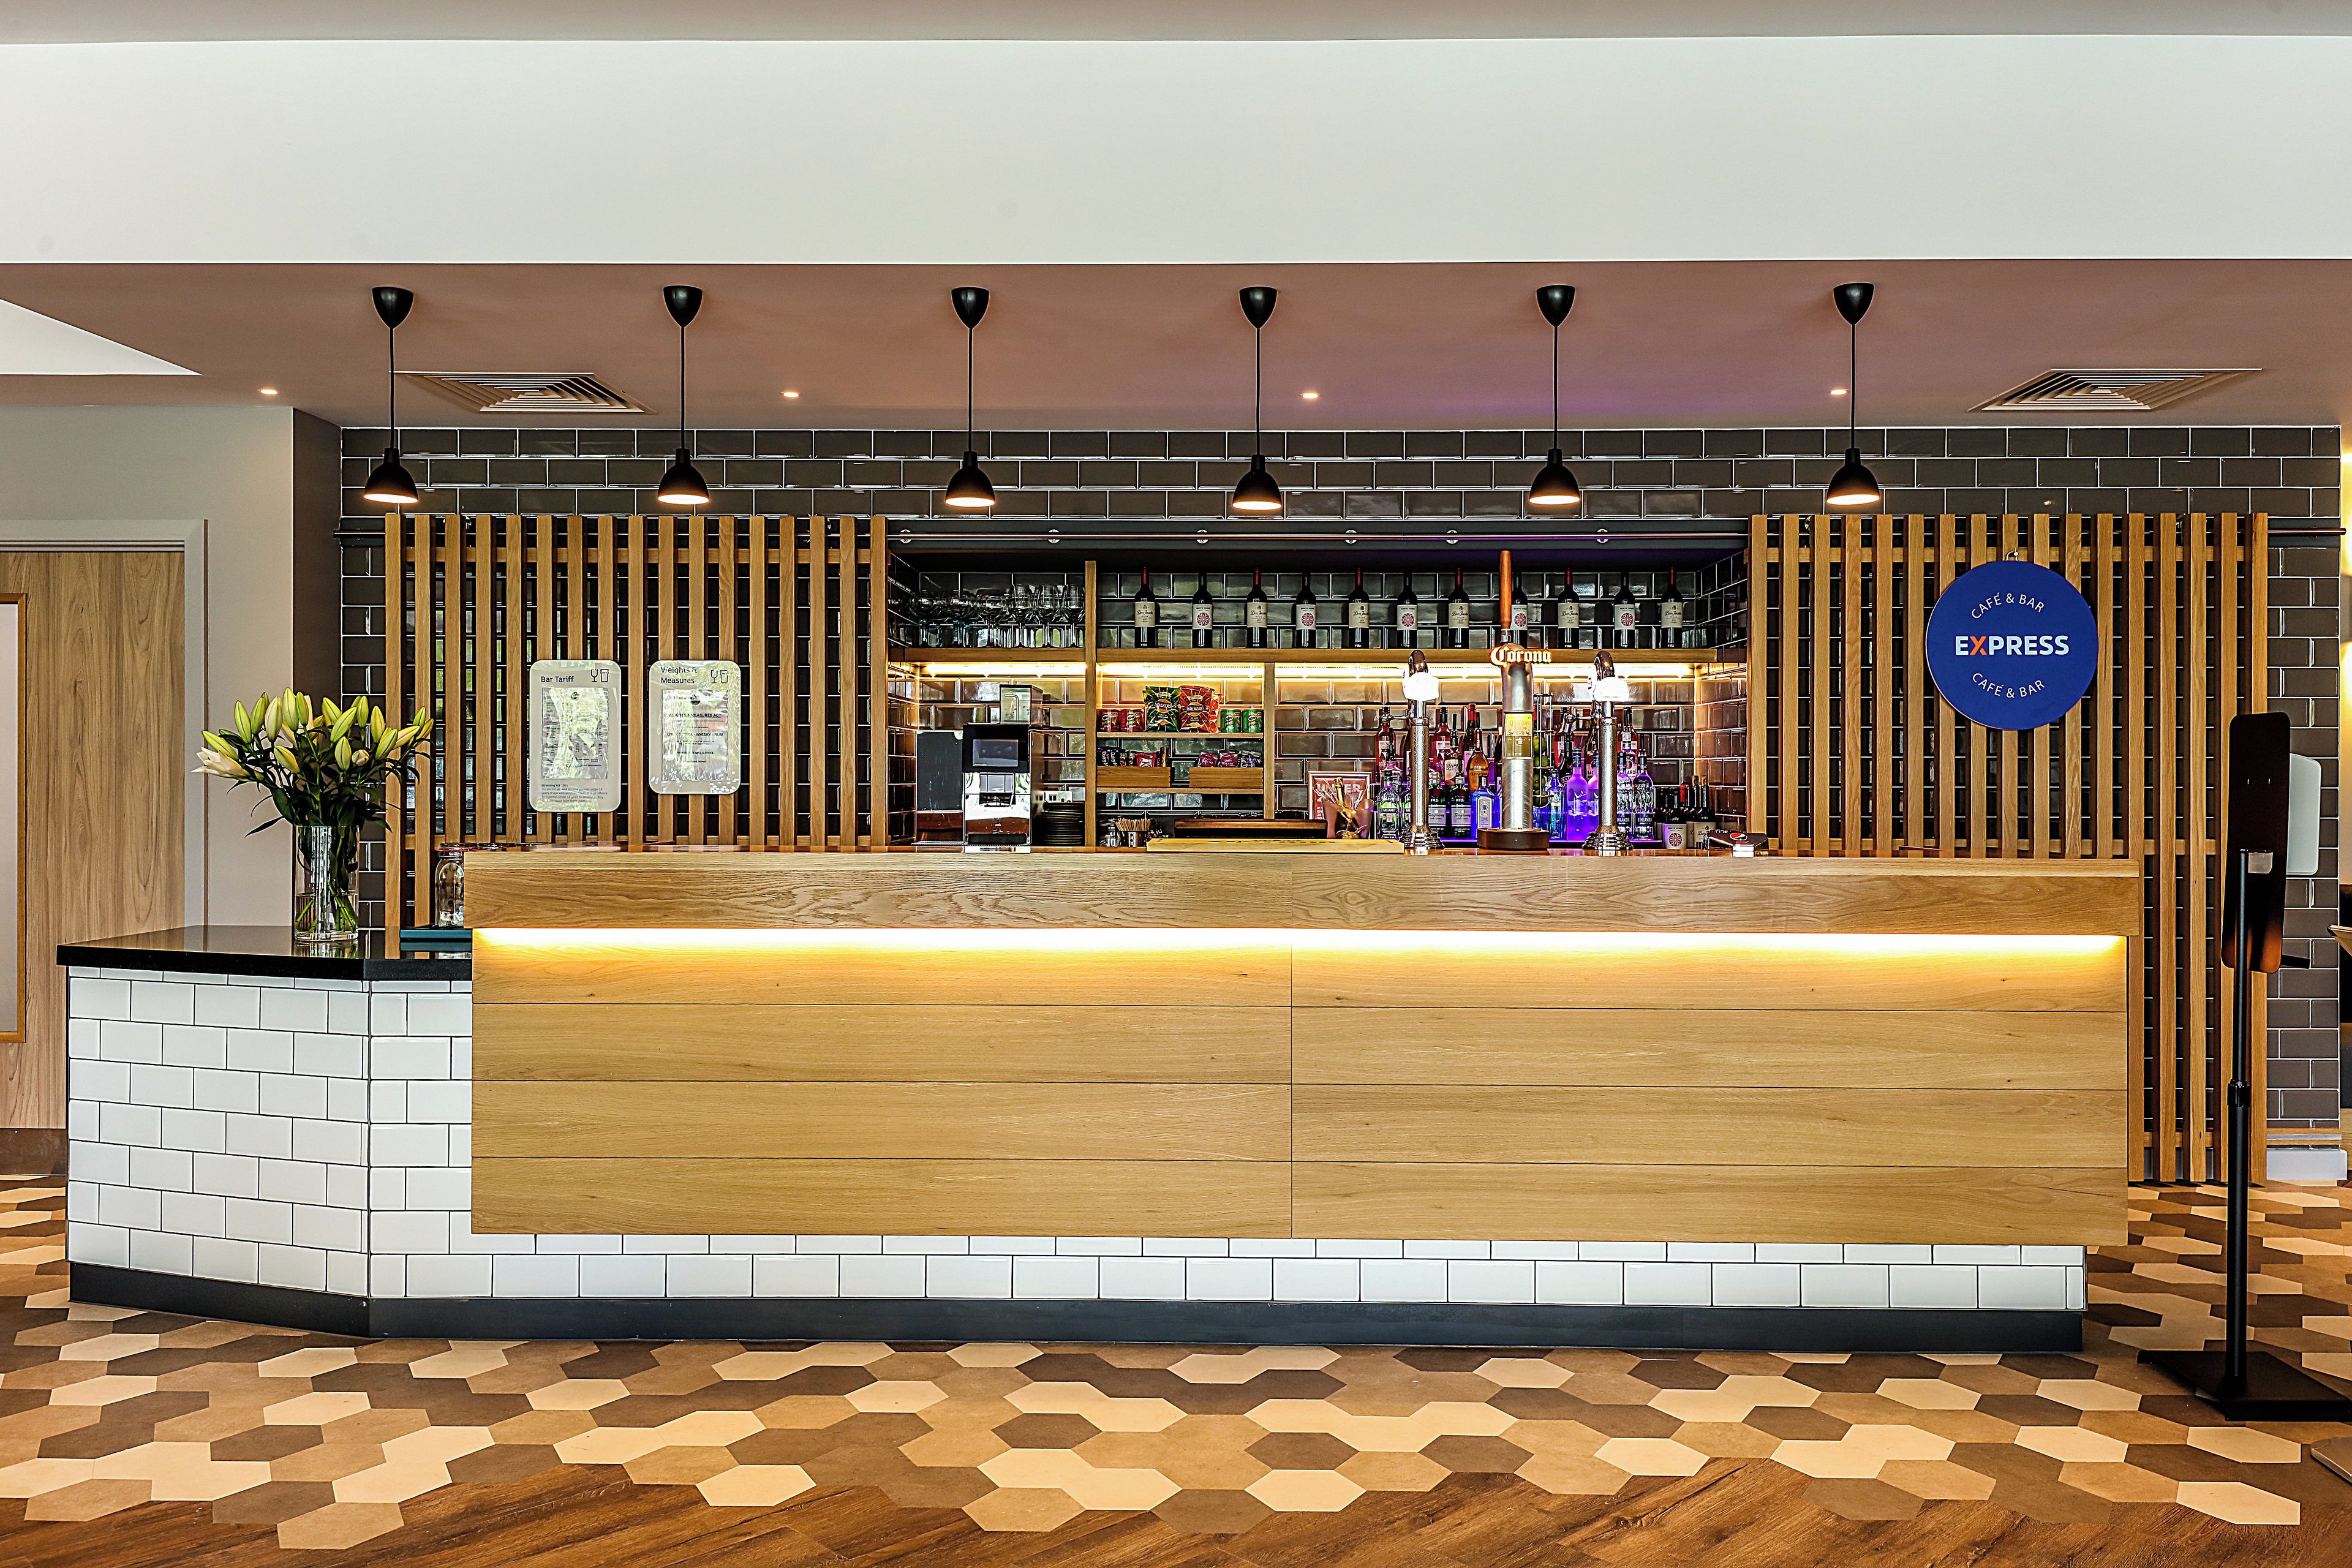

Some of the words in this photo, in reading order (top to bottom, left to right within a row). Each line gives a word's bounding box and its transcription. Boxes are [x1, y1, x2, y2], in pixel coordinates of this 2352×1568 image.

[1971, 592, 2002, 619] CAFÉ
[2006, 593, 2015, 603] &
[2019, 594, 2045, 612] BAR
[1955, 635, 2070, 655] EXPRESS
[1490, 646, 1551, 668] Corona
[661, 666, 690, 675] Weights
[1972, 673, 2004, 696] CAFÉ
[2006, 688, 2015, 698] &
[2019, 680, 2045, 697] BAR
[1317, 784, 1362, 793] UNER
